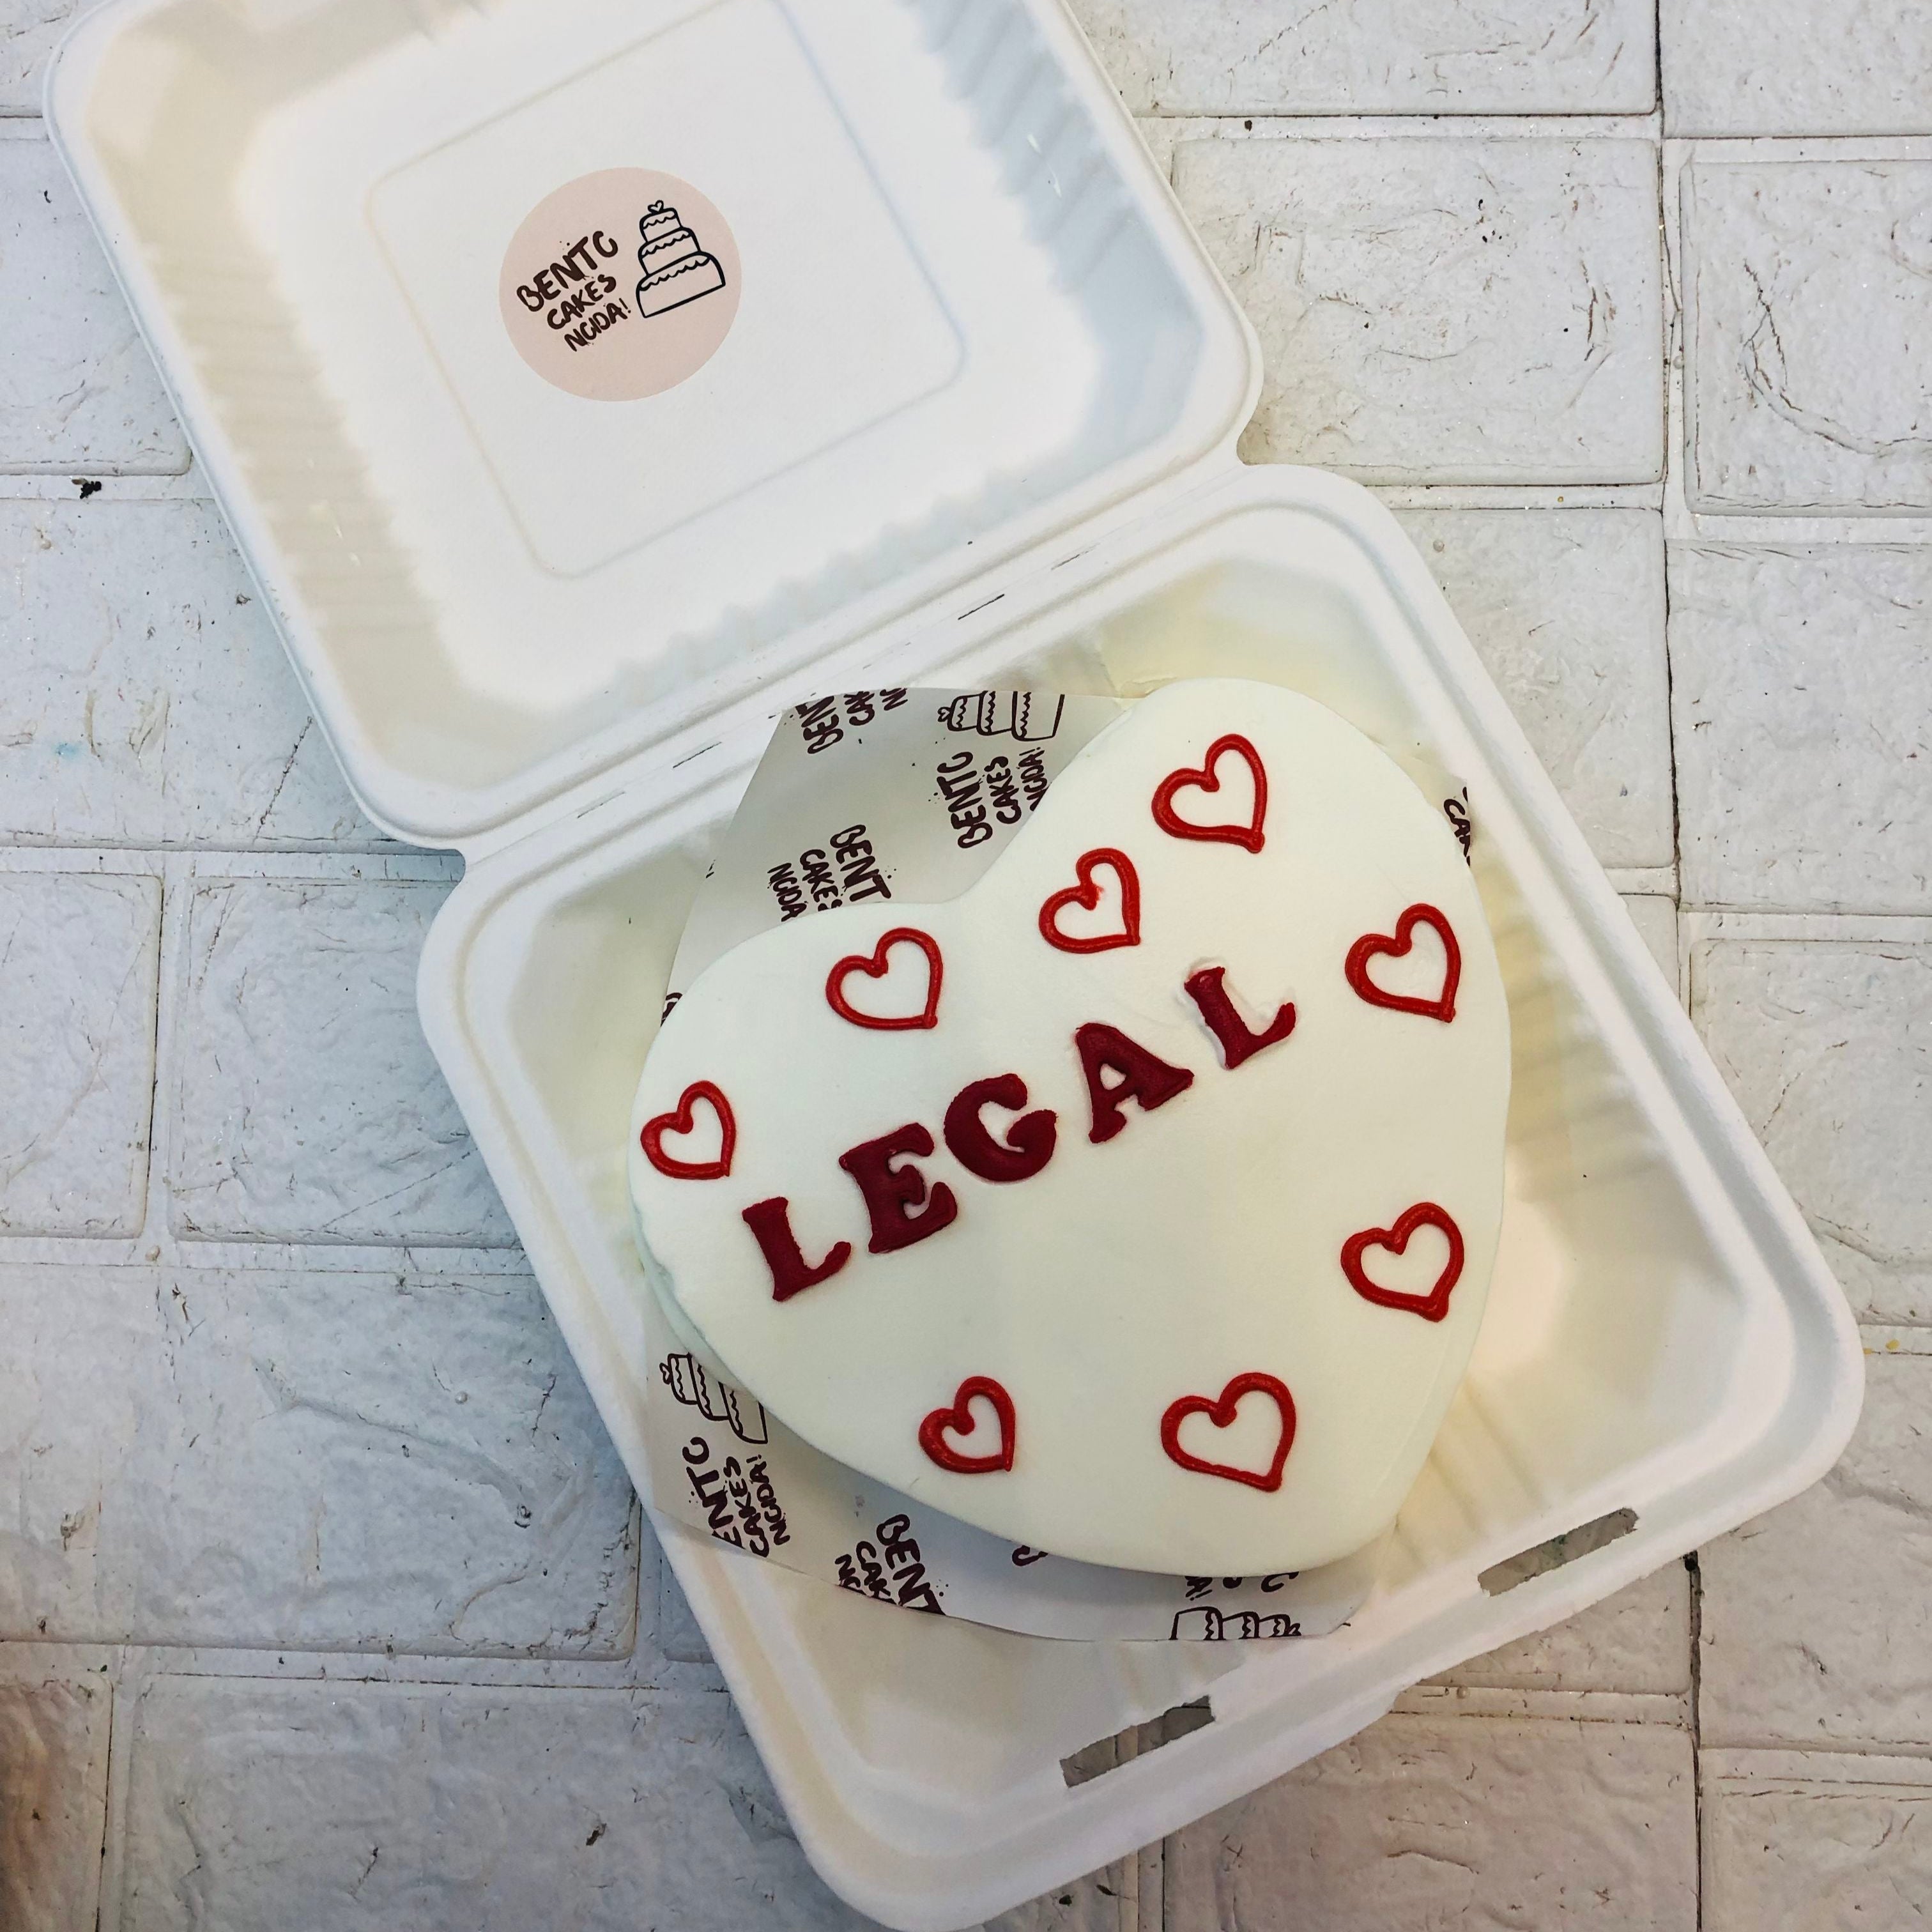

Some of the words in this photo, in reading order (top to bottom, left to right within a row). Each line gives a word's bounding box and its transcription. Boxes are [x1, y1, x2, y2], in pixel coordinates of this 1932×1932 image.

[547, 274, 617, 330] CAKES
[984, 756, 1022, 825] CAKES
[742, 965, 1297, 1302] LEGAL
[723, 1456, 770, 1558] CAKES
